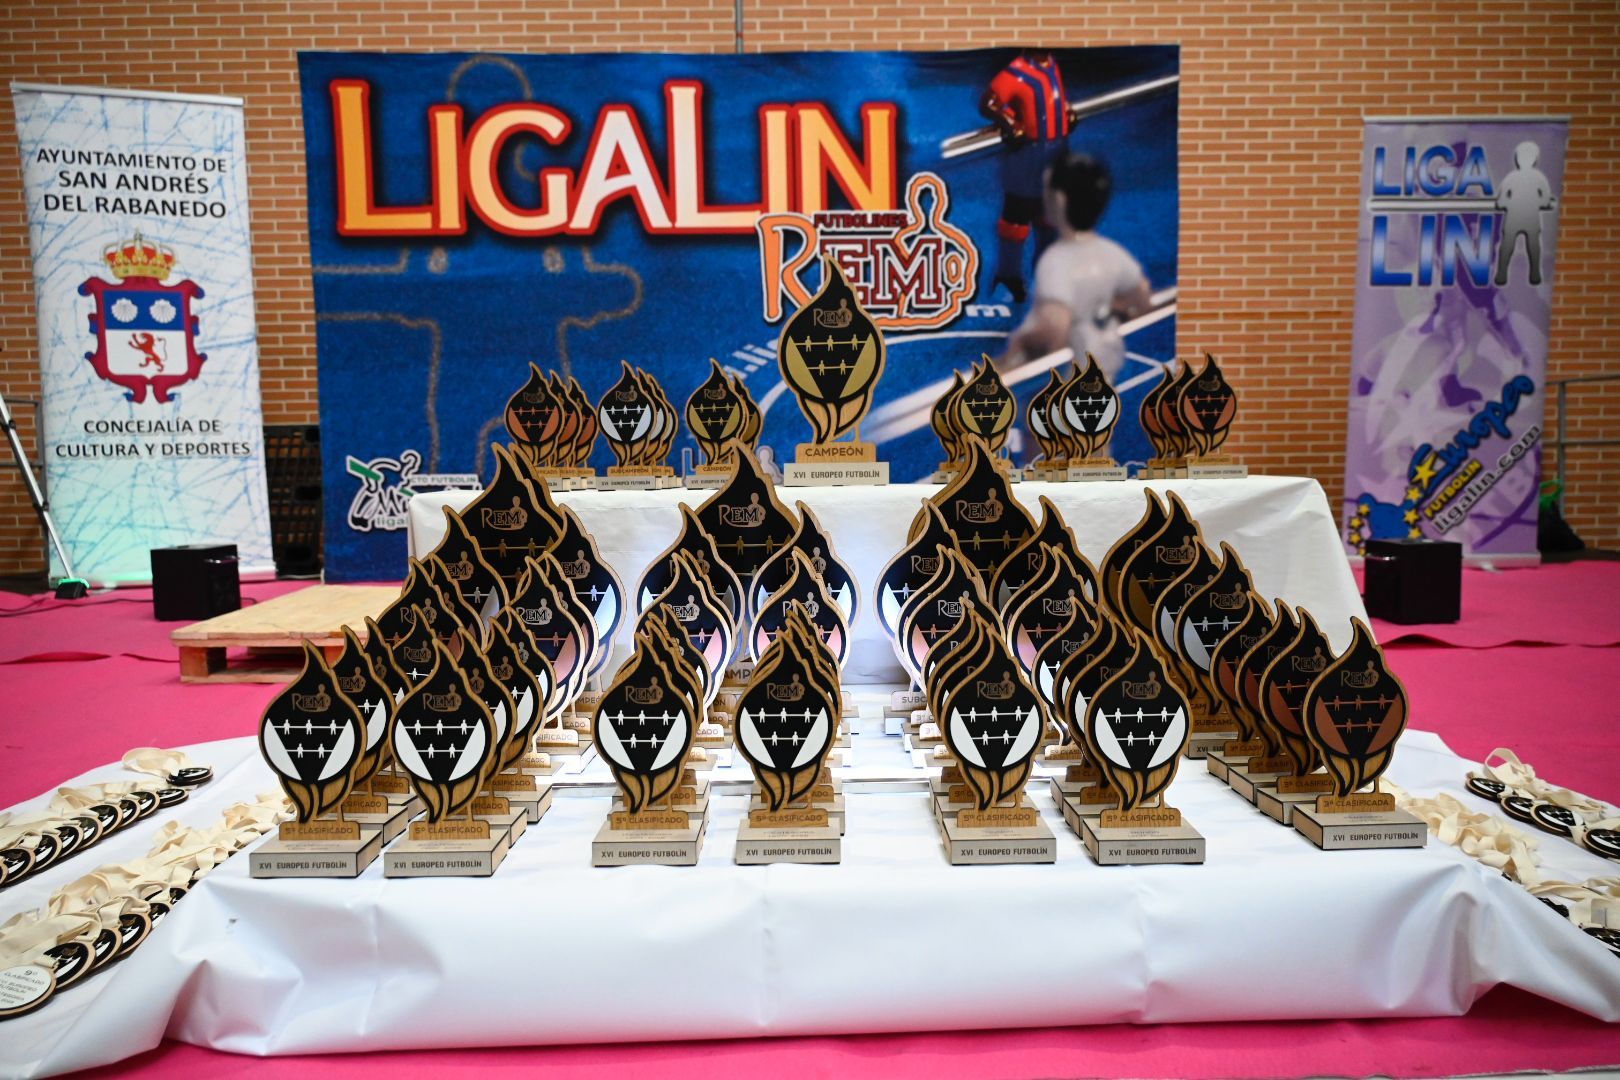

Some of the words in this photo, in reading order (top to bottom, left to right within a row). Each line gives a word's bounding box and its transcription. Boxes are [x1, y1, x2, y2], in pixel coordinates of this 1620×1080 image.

[37, 149, 198, 172] AYUNTAMIENTO
[203, 157, 228, 173] DE
[329, 78, 898, 237] LIGALIN
[1372, 144, 1496, 197] LIGA
[59, 170, 107, 190] SAN
[115, 173, 209, 194] ANDRÉS
[44, 193, 88, 213] DEL
[95, 196, 227, 219] RABANEDO
[814, 213, 909, 228] FUTBOLINES
[1369, 213, 1495, 287] LIN
[84, 416, 194, 435] CONCEJALÍA
[199, 420, 222, 434] DE
[56, 443, 140, 458] CULTURA
[146, 443, 157, 456] Y
[161, 441, 250, 457] DEPORTES
[805, 446, 864, 457] CAMPEÓN
[793, 471, 807, 479] XVI
[810, 470, 843, 479] EUROPEO
[845, 469, 880, 479] FUTBOLÍN
[1433, 426, 1540, 534] ligalin.com
[1423, 459, 1483, 519] FUTBOLIN
[1336, 799, 1389, 807] CLASIFICADA
[628, 816, 683, 824] CLASIFICADO
[768, 814, 823, 822] CLASIFICADO
[976, 813, 1031, 821] CLASIFICADO
[298, 826, 353, 834] CLASIFICADO
[428, 826, 483, 834] CLASIFICADO
[1350, 833, 1382, 841] EUROPEO
[1384, 831, 1419, 840] FUTBOLÍN
[618, 850, 651, 858] EUROPEO
[653, 849, 687, 857] FUTBOLÍN
[763, 848, 796, 856] EUROPEO
[798, 847, 832, 855] FUTBOLÍN
[978, 848, 1011, 856] EUROPEO
[1013, 847, 1048, 855] FUTBOLÍN
[1126, 848, 1159, 856] EUROPEO
[1161, 847, 1197, 855] FUTBOLÍN
[276, 862, 310, 870] EUROPEO
[312, 861, 347, 869] FUTBOLÍN
[411, 861, 445, 869] EUROPEO
[447, 860, 482, 868] FUTBOLÍN
